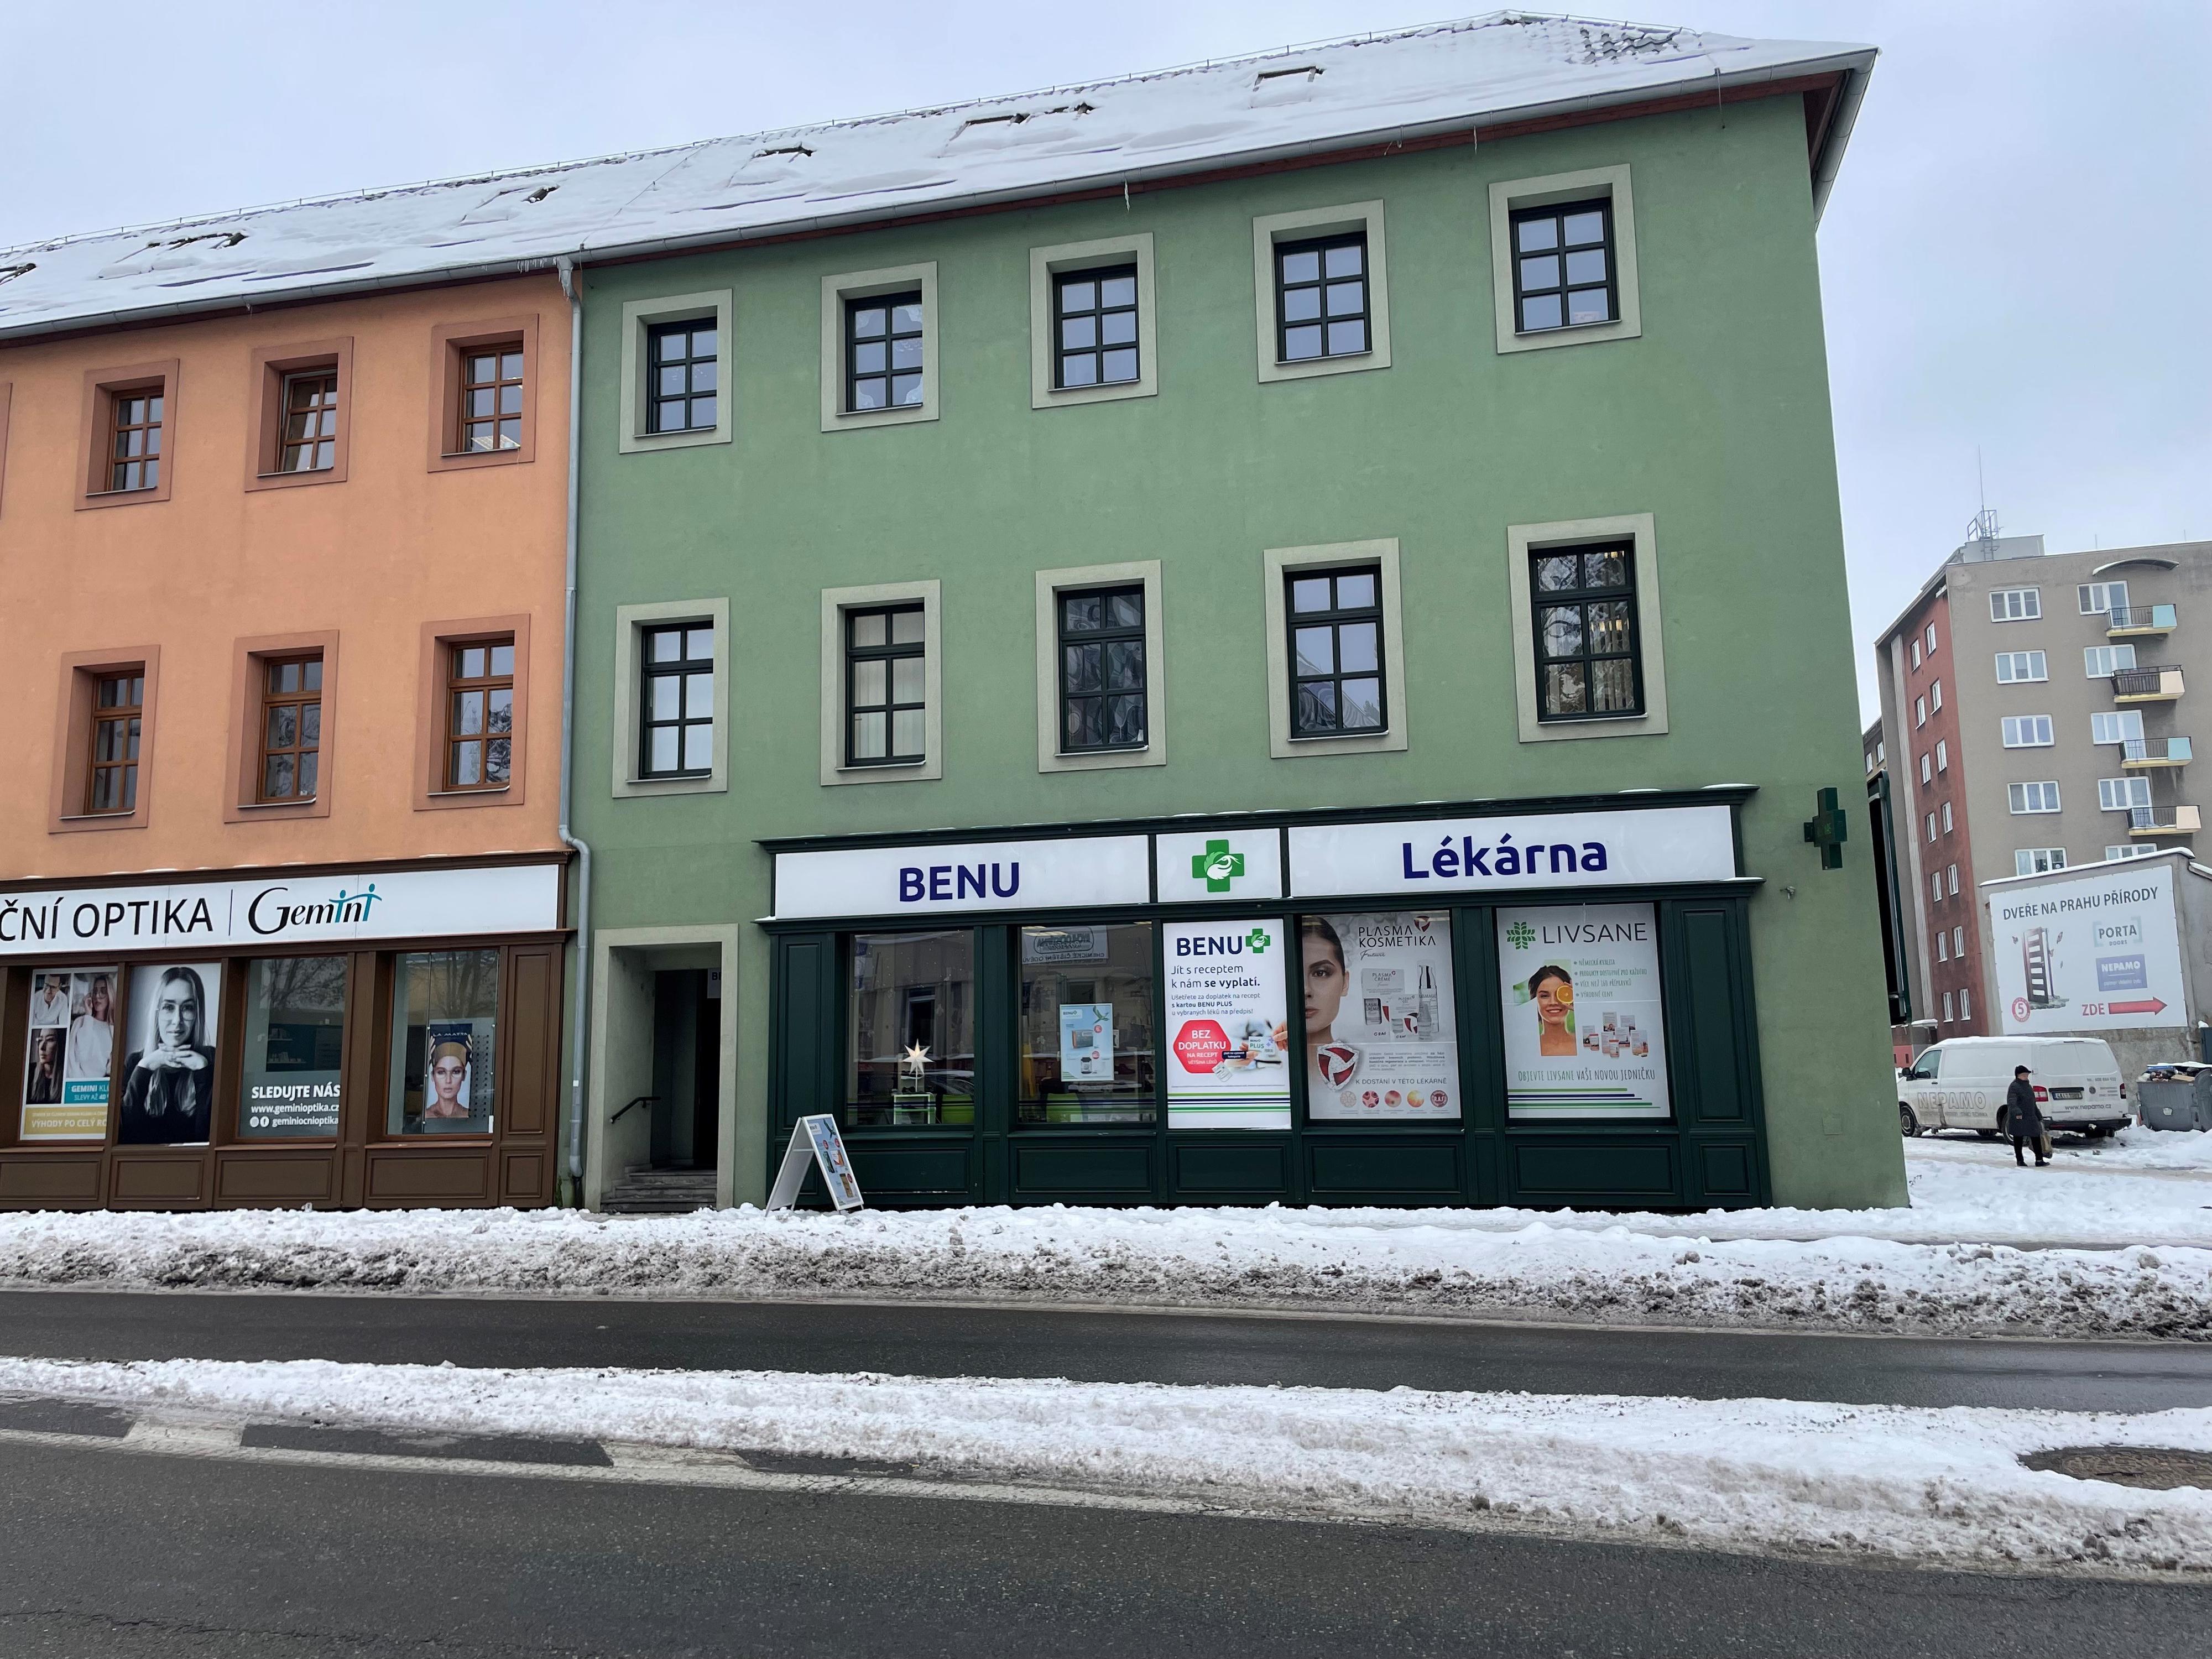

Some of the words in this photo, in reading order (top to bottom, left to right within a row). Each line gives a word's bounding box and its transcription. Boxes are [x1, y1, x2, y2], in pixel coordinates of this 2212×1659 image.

[1402, 833, 1608, 879] Lékárna
[900, 862, 1019, 902] BENU
[248, 883, 382, 935] Gemini
[2003, 903, 2038, 920] DVEŘE
[2041, 902, 2057, 915] NA
[2060, 895, 2100, 912] PRAHU
[2104, 886, 2158, 906] PŘÍRODY
[0, 897, 64, 941] ČNÍ
[73, 898, 213, 938] OPTIKA
[1359, 925, 1413, 937] PLASMA
[1543, 922, 1648, 944] LIVSANE
[2099, 925, 2137, 939] PORTA
[1177, 936, 1243, 956] BENU
[1359, 935, 1436, 948] KOSMETIKA
[1171, 965, 1184, 974] Jít
[1194, 964, 1243, 975] receptem
[2101, 961, 2141, 972] NEPAMO
[1172, 979, 1177, 988] k
[1180, 979, 1201, 988] nám
[1219, 977, 1260, 989] vyplatí.
[2018, 1003, 2024, 1015] 5
[2081, 1003, 2105, 1016] ZDE
[1192, 1030, 1211, 1039] BEZ
[1178, 1041, 1227, 1050] DOPLATKU
[1518, 1070, 1544, 1081] OBJEVTE
[1546, 1070, 1574, 1081] LIVSANE
[1577, 1067, 1593, 1081] VAŠI
[1594, 1070, 1618, 1080] NOVOU
[1621, 1067, 1655, 1081] JEDNIČKU
[252, 1085, 310, 1101] SLEDUJTE
[313, 1081, 341, 1098] NÁS
[1917, 1092, 1986, 1109] NEPAMO
[251, 1103, 340, 1115] www.geminioptika.cz
[32, 1119, 62, 1128] VÝHODY
[77, 1118, 96, 1126] CELÝ
[272, 1116, 339, 1128] geminiocnioptika
